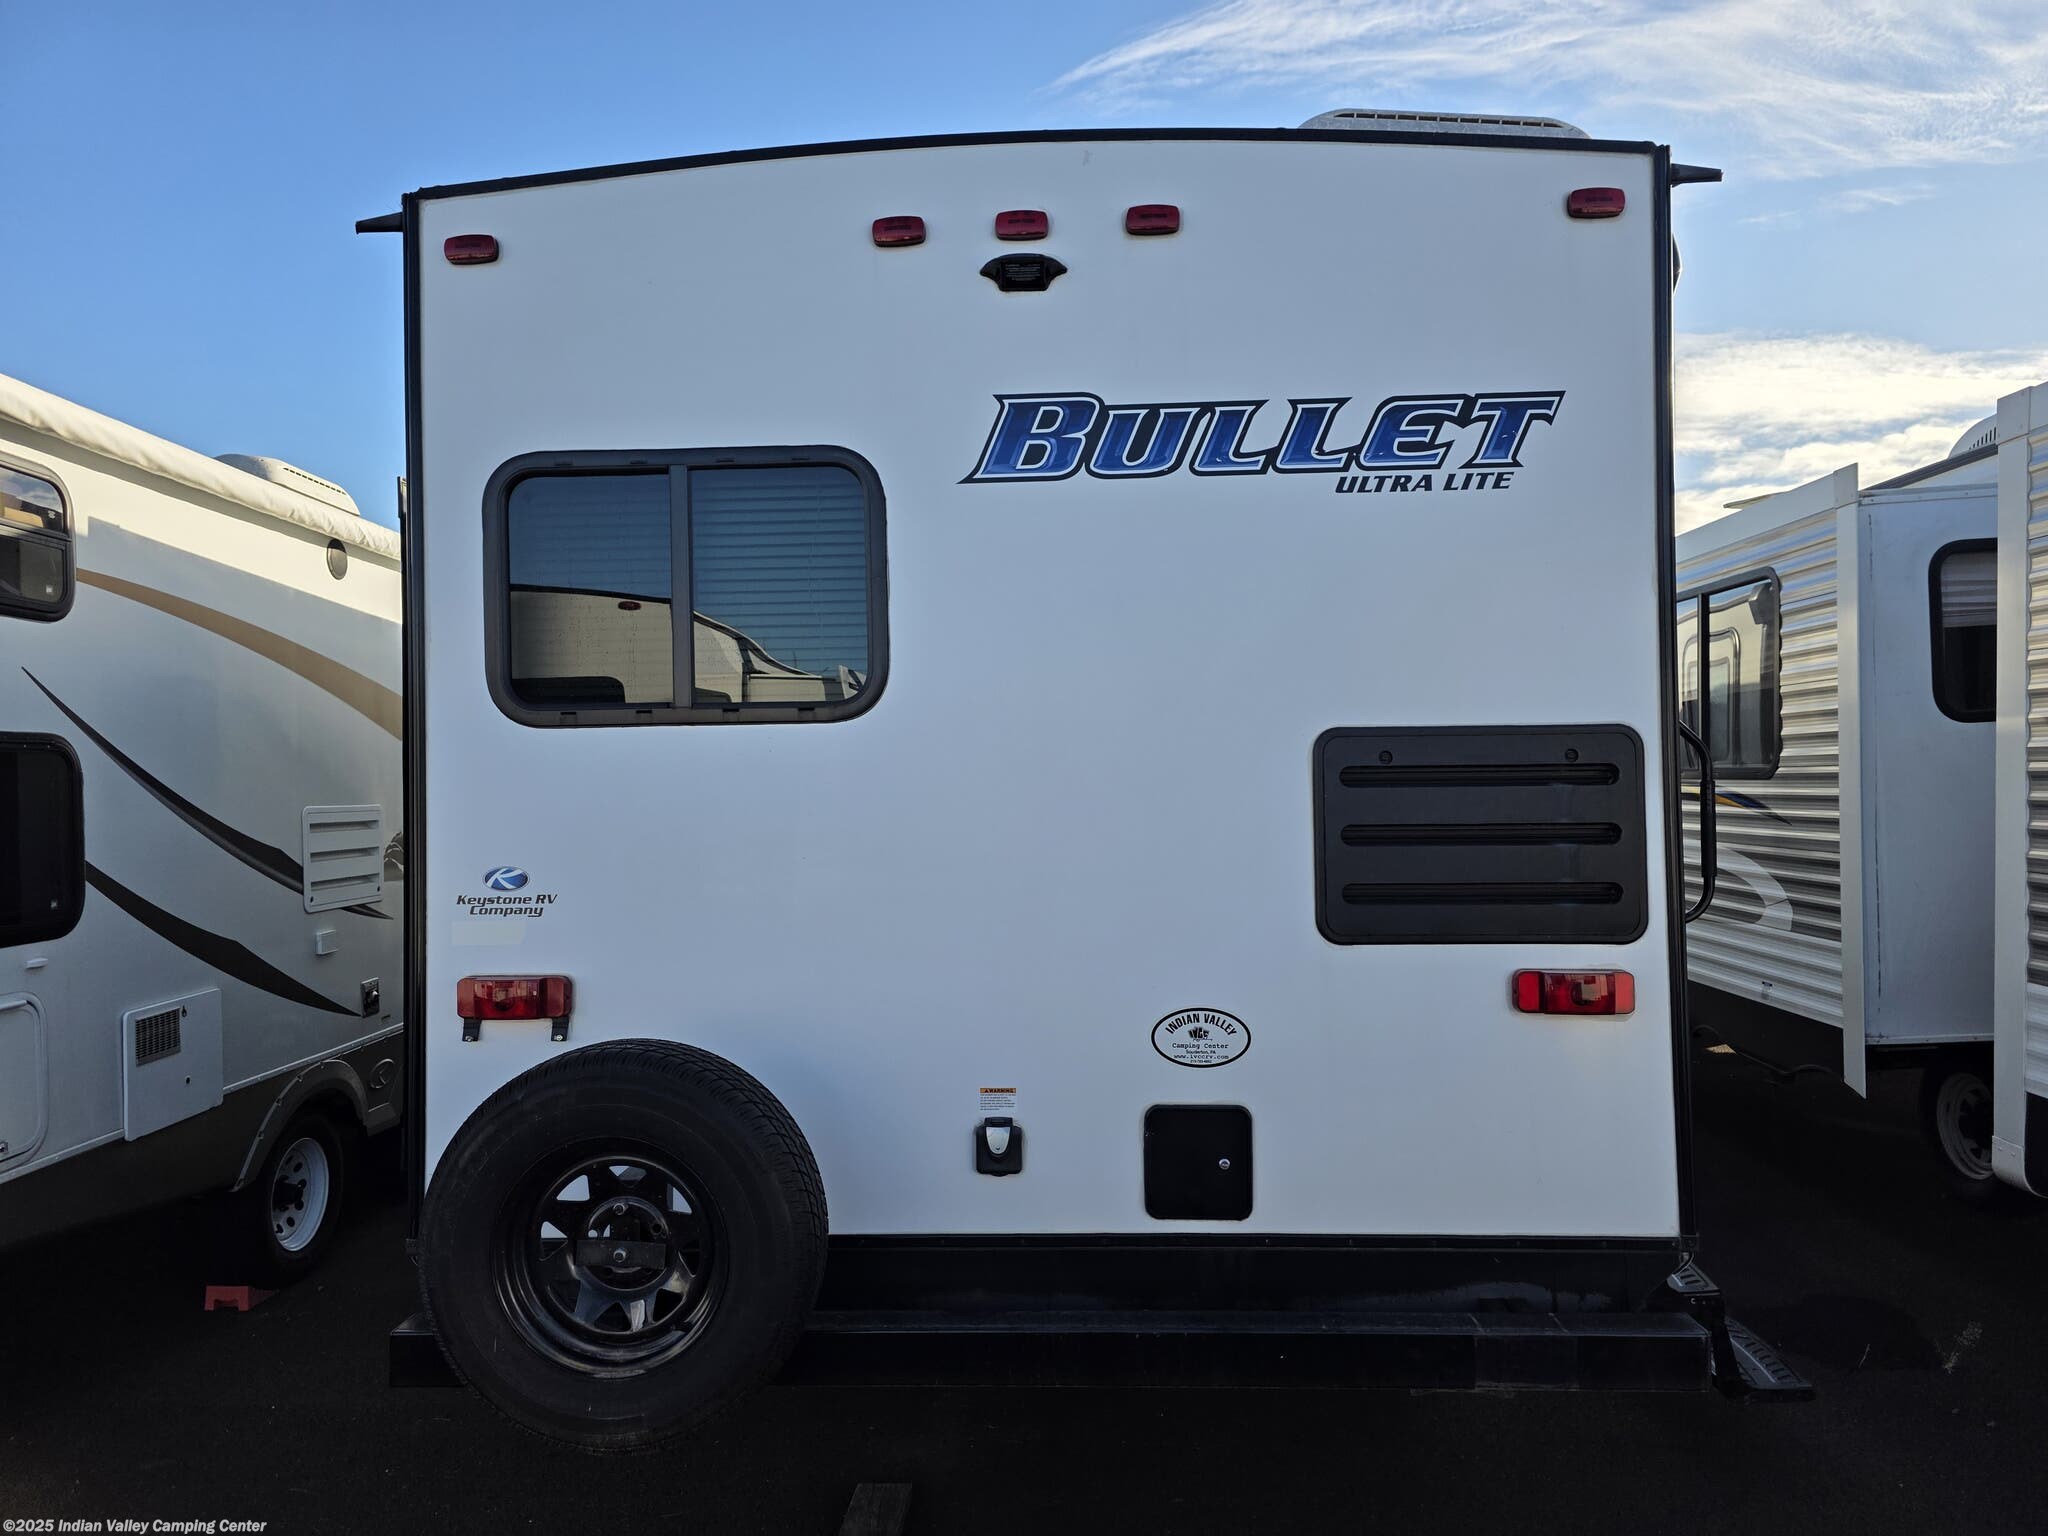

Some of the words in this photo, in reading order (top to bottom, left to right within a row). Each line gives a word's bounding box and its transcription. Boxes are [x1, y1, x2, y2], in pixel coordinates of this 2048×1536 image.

[1335, 474, 1433, 494] ULTRA
[1443, 471, 1515, 491] LITE
[456, 894, 533, 908] Keystone
[535, 893, 558, 904] RV
[469, 905, 544, 918] Company
[1165, 1013, 1200, 1034] INDIAN
[1204, 1013, 1237, 1036] VALLEY
